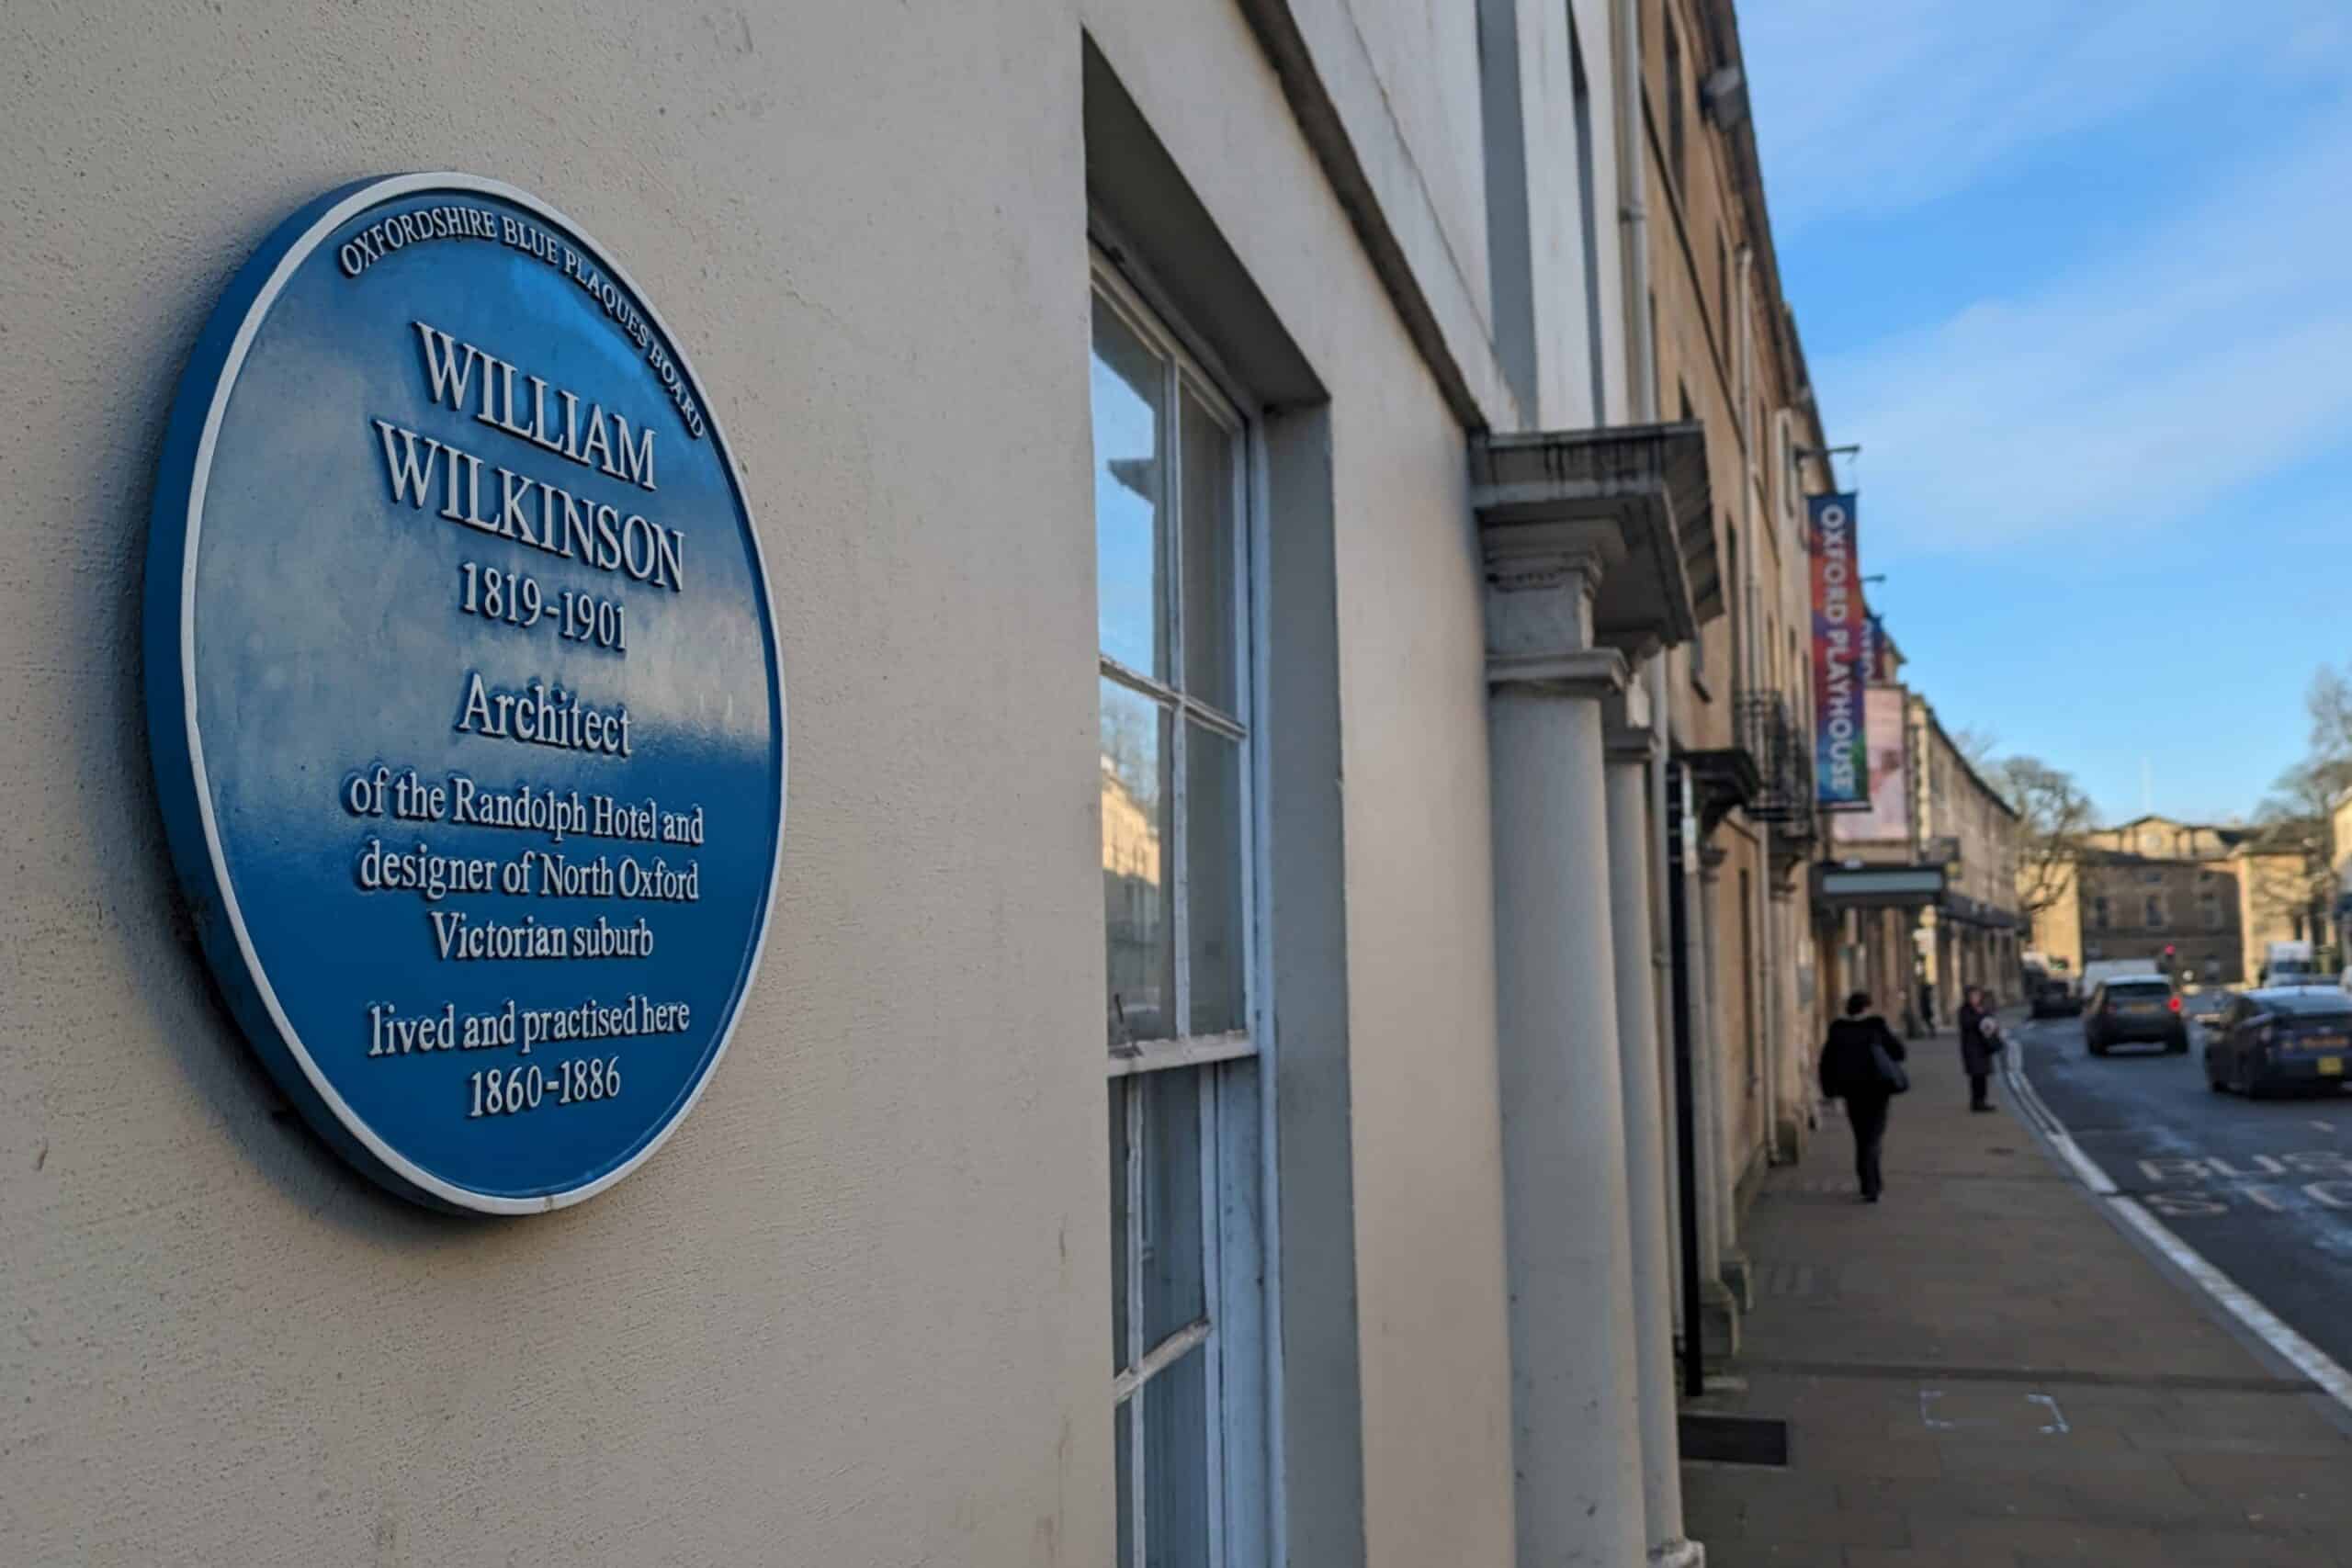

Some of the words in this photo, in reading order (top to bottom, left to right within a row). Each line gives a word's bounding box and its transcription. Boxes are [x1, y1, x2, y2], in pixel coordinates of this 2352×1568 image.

[341, 206, 498, 276] OXFORDSHIRE
[502, 219, 559, 265] BLUE
[563, 249, 648, 347] PLAQUES
[649, 344, 706, 439] BOARD
[414, 321, 657, 491] WILLIAM
[376, 419, 684, 592] WILKINSON
[463, 561, 627, 649] 1819-1901
[1821, 504, 1849, 624] OXFORD
[458, 672, 632, 757] Architect
[1825, 629, 1855, 792] PLAYHOUSE
[351, 767, 390, 813] of
[396, 772, 447, 819] the
[453, 778, 586, 841] Randolph
[593, 795, 657, 840] Hotel
[662, 807, 704, 843] and
[361, 840, 497, 900] designer
[503, 851, 536, 894] of
[540, 853, 614, 897] North
[618, 857, 699, 900] Oxford
[431, 911, 567, 959] Victorian
[572, 916, 654, 957] suburb
[368, 1003, 455, 1055] lived
[463, 999, 515, 1049] and
[521, 995, 638, 1054] practised
[641, 995, 691, 1032] here
[469, 1055, 622, 1118] 1860-1886
